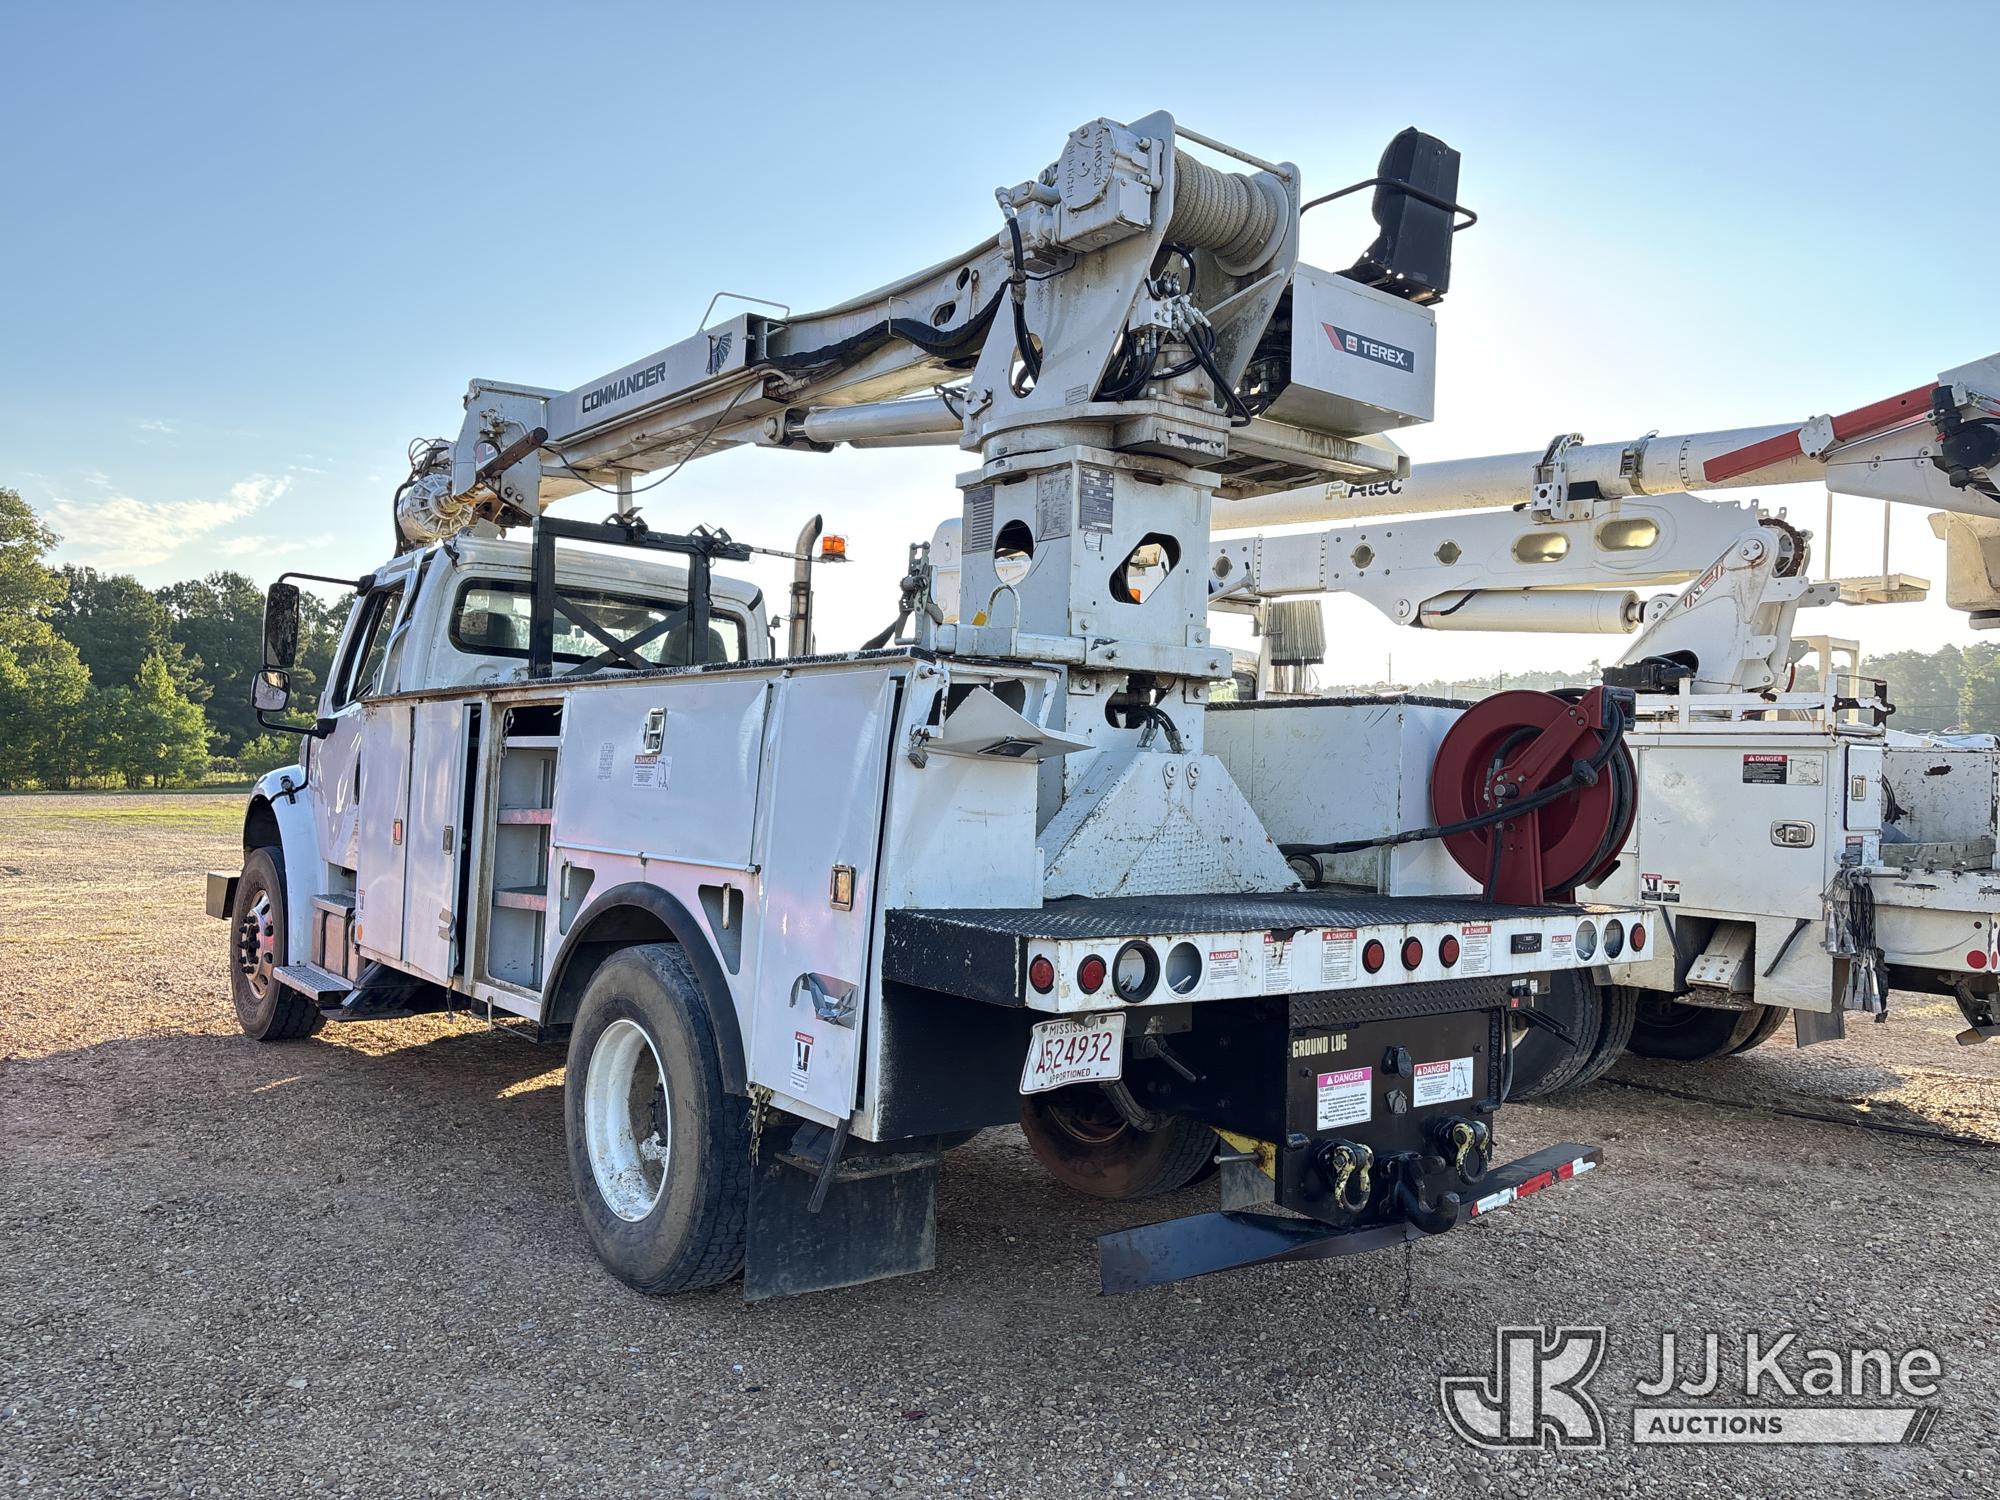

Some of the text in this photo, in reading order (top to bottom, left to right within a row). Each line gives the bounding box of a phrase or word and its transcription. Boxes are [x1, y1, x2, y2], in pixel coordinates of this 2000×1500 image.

[1361, 340, 1405, 366] TEREX
[582, 361, 666, 413] COMMANDER
[1036, 1032, 1112, 1074] A524932
[1292, 1034, 1347, 1058] GROUND LUG
[1049, 1068, 1090, 1083] APPORTIONED
[1334, 1071, 1363, 1083] DANGER
[1423, 1063, 1449, 1075] DANGER
